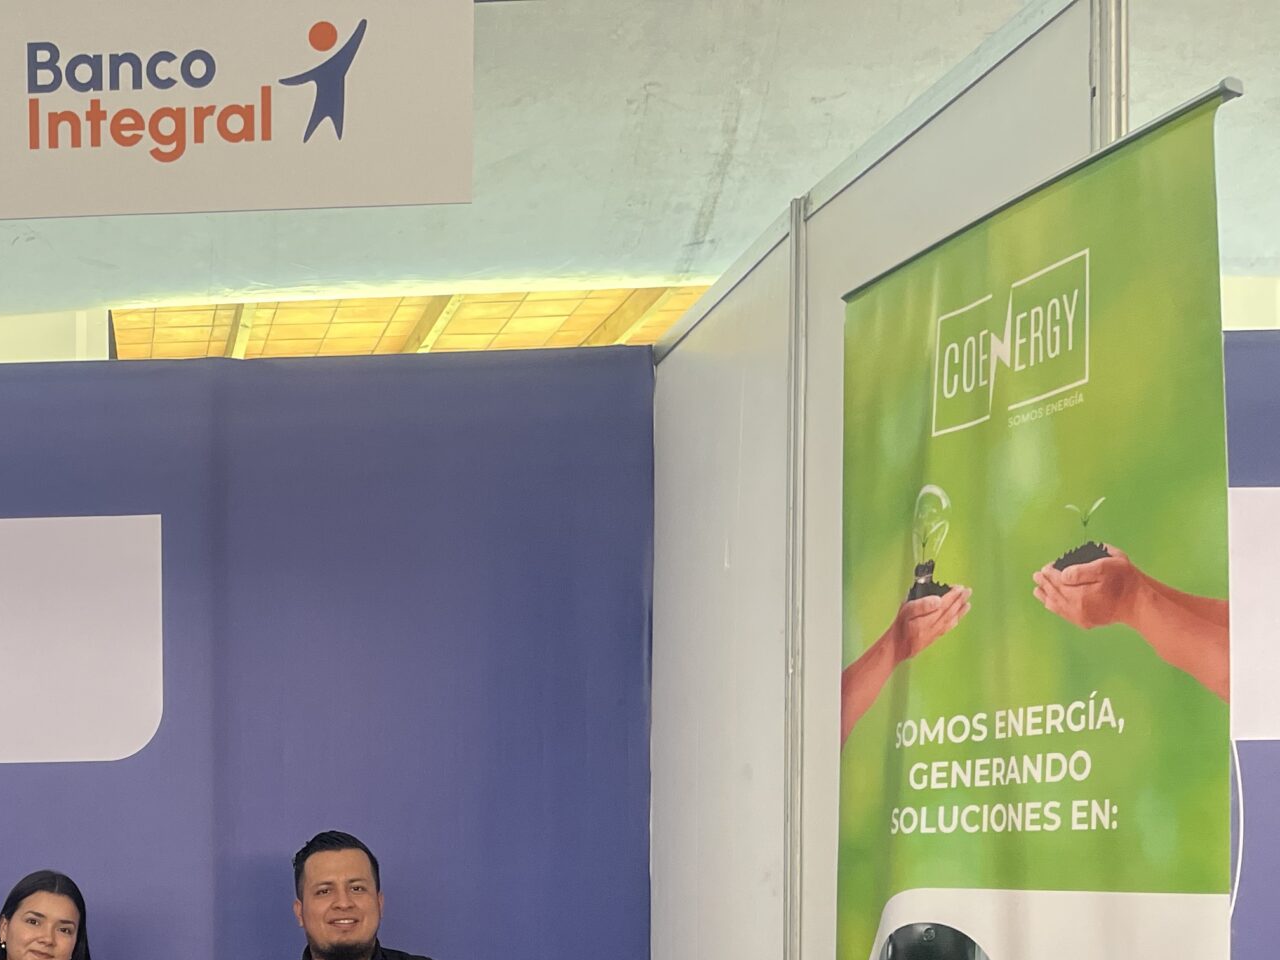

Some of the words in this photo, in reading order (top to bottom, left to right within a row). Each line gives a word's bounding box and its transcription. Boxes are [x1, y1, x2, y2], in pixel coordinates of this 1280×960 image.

[27, 41, 217, 94] Banco
[28, 86, 273, 163] Integral
[943, 286, 1079, 416] COENERGY
[1007, 408, 1044, 429] SOMOS
[1045, 391, 1084, 418] ENERGÍA
[895, 710, 987, 750] SOMOS
[995, 690, 1126, 740] ENERGÍA,
[908, 749, 1092, 790] GENERANDO
[890, 801, 1061, 836] SOLUCIONES
[1071, 797, 1119, 831] EN:
